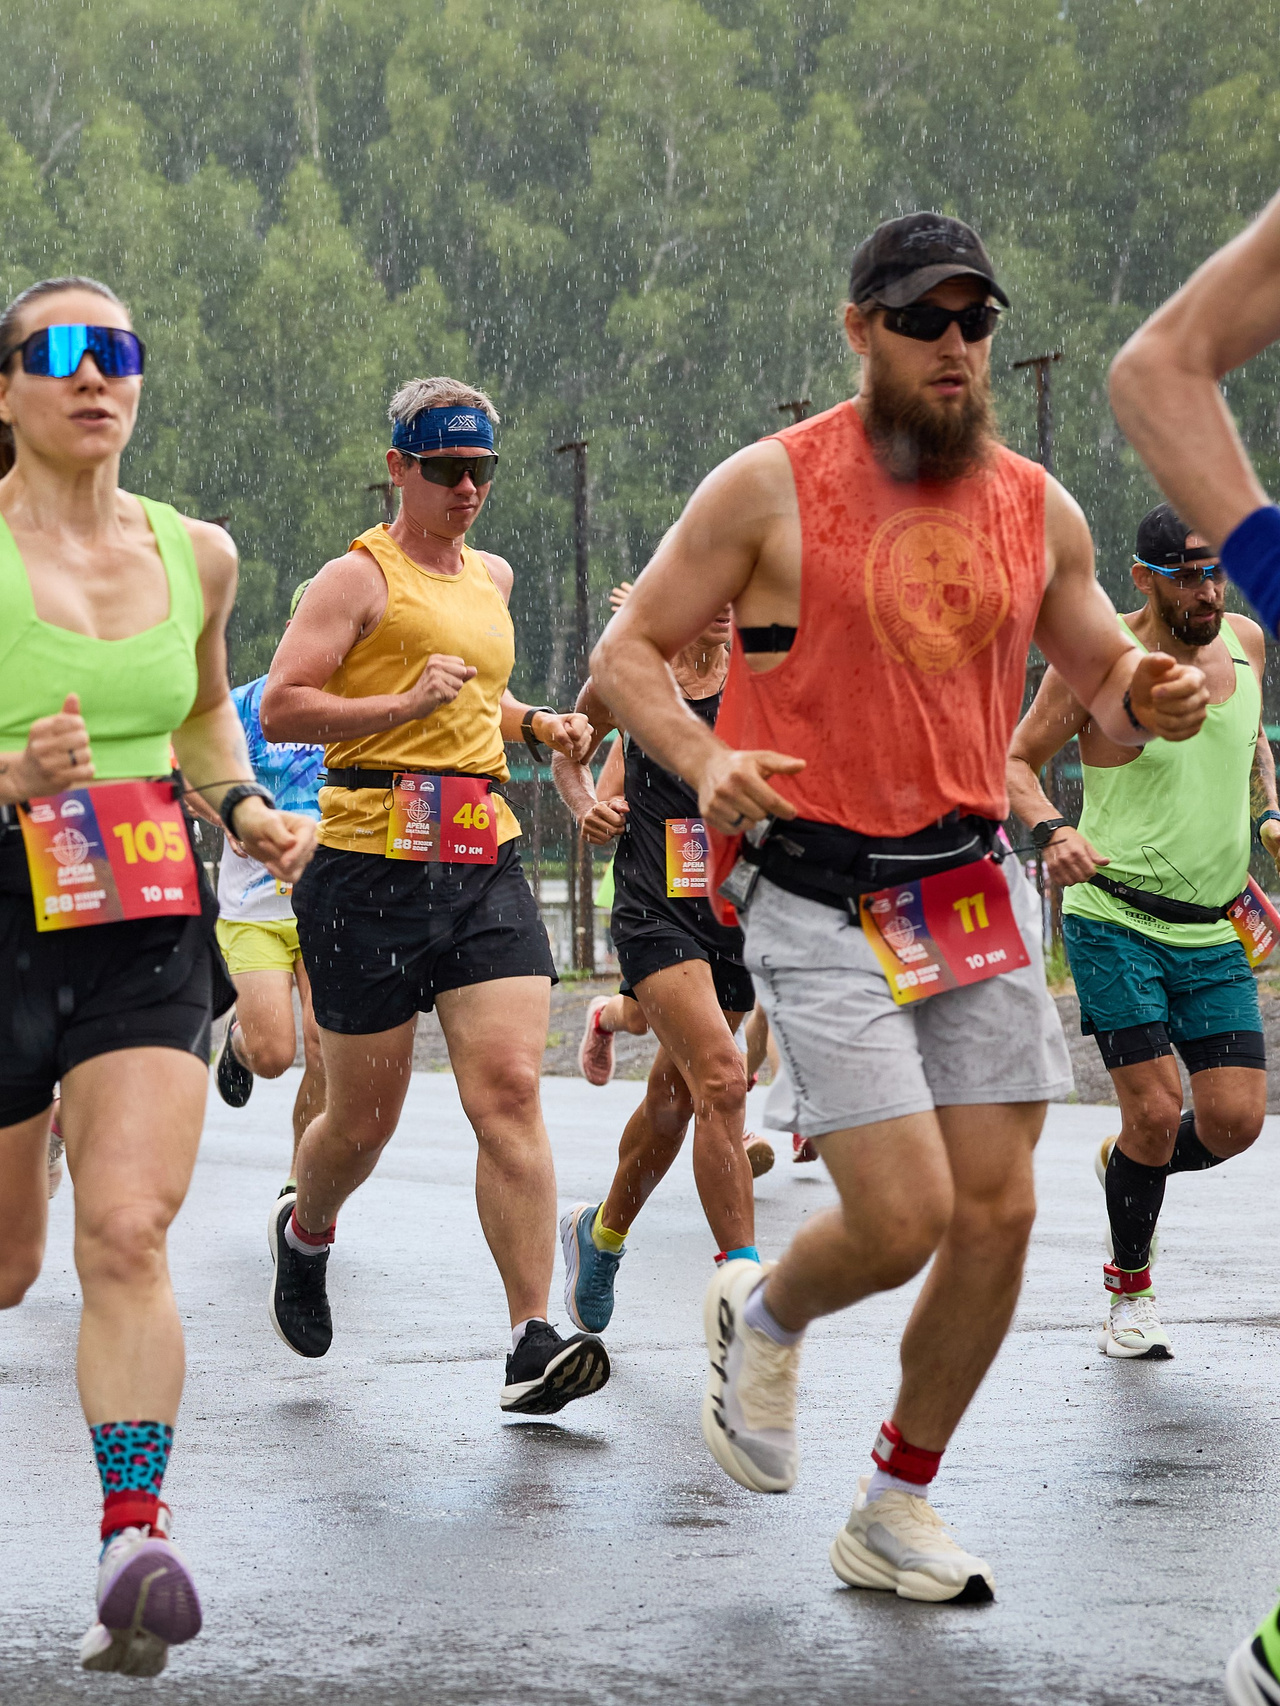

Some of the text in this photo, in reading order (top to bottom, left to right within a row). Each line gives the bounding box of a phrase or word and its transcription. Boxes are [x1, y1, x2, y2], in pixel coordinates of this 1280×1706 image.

[453, 803, 490, 830] 46
[112, 820, 186, 865] 105
[393, 838, 412, 850] 28
[454, 844, 466, 854] 10
[672, 877, 690, 888] 28
[141, 885, 162, 902] 10
[953, 892, 990, 934] 11
[965, 953, 985, 970] 10
